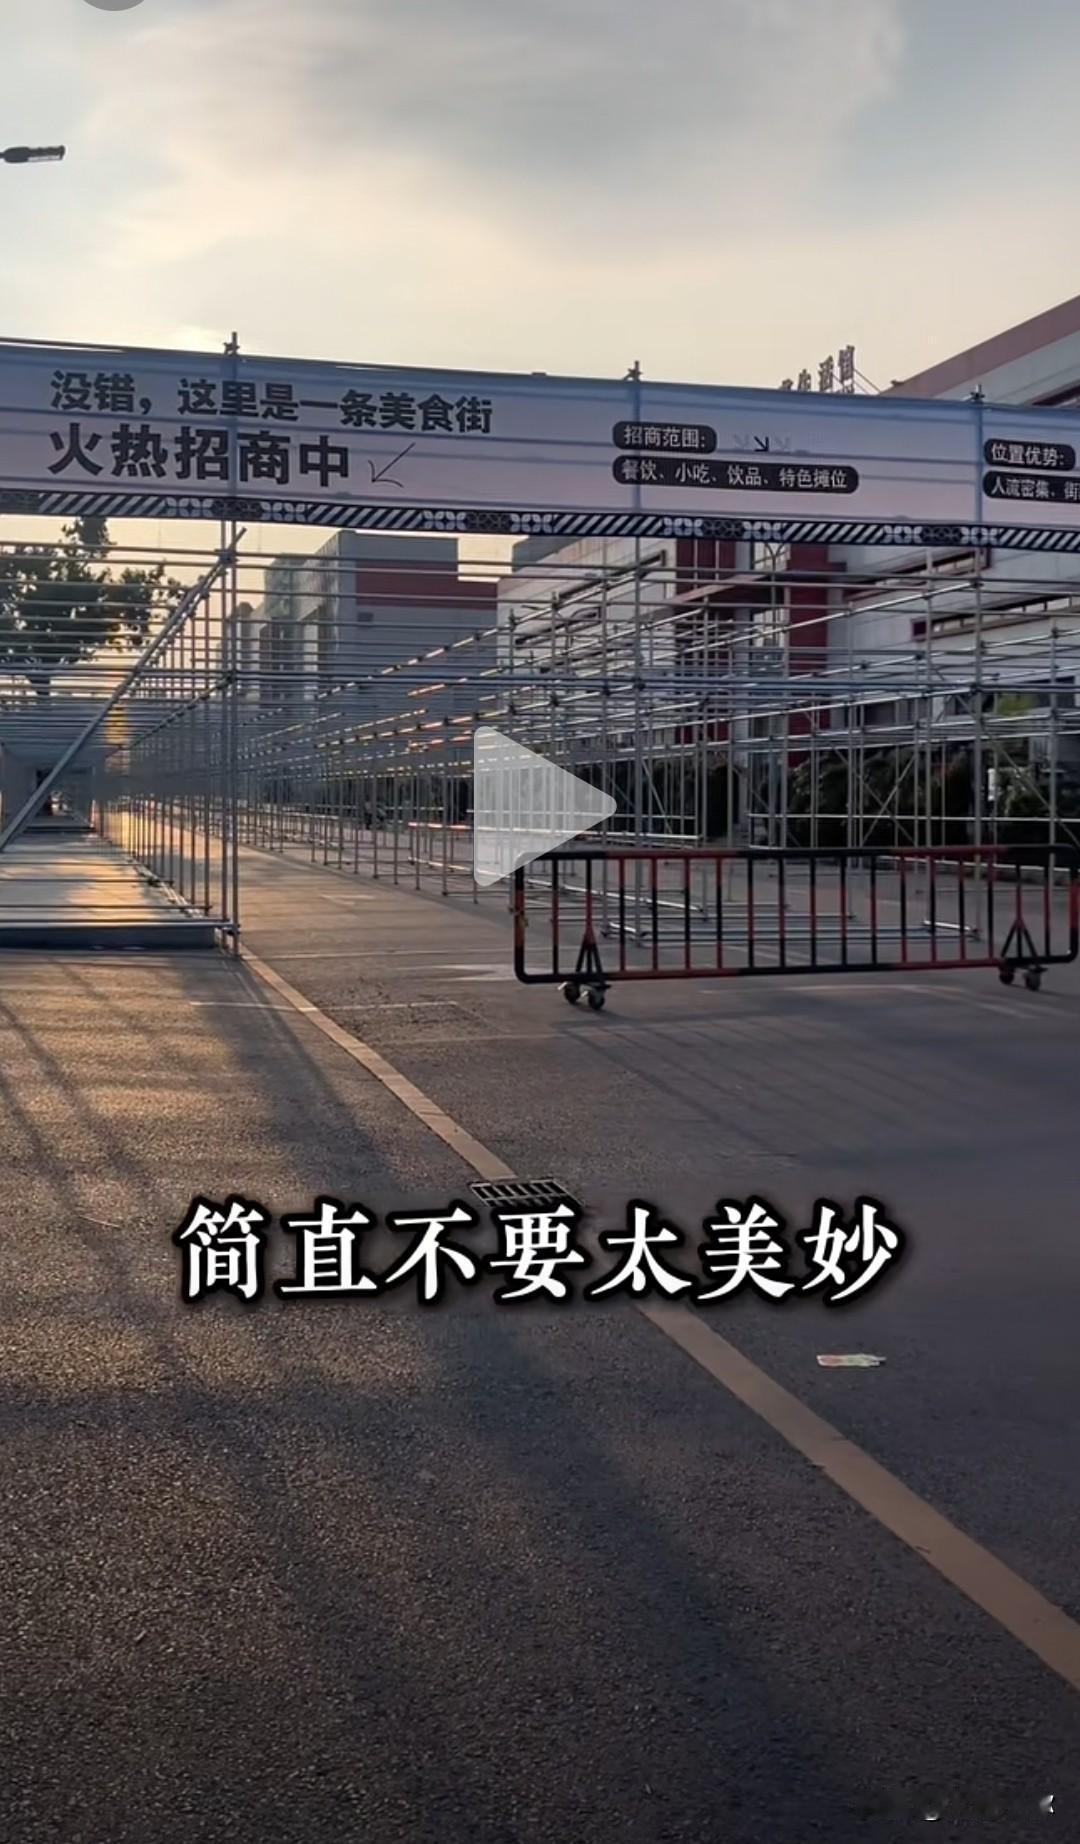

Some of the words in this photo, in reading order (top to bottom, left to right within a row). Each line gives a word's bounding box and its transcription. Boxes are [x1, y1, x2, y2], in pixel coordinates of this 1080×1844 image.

[51, 369, 493, 434] 没错，这里是一条美食街
[48, 422, 350, 488] 火热招商中
